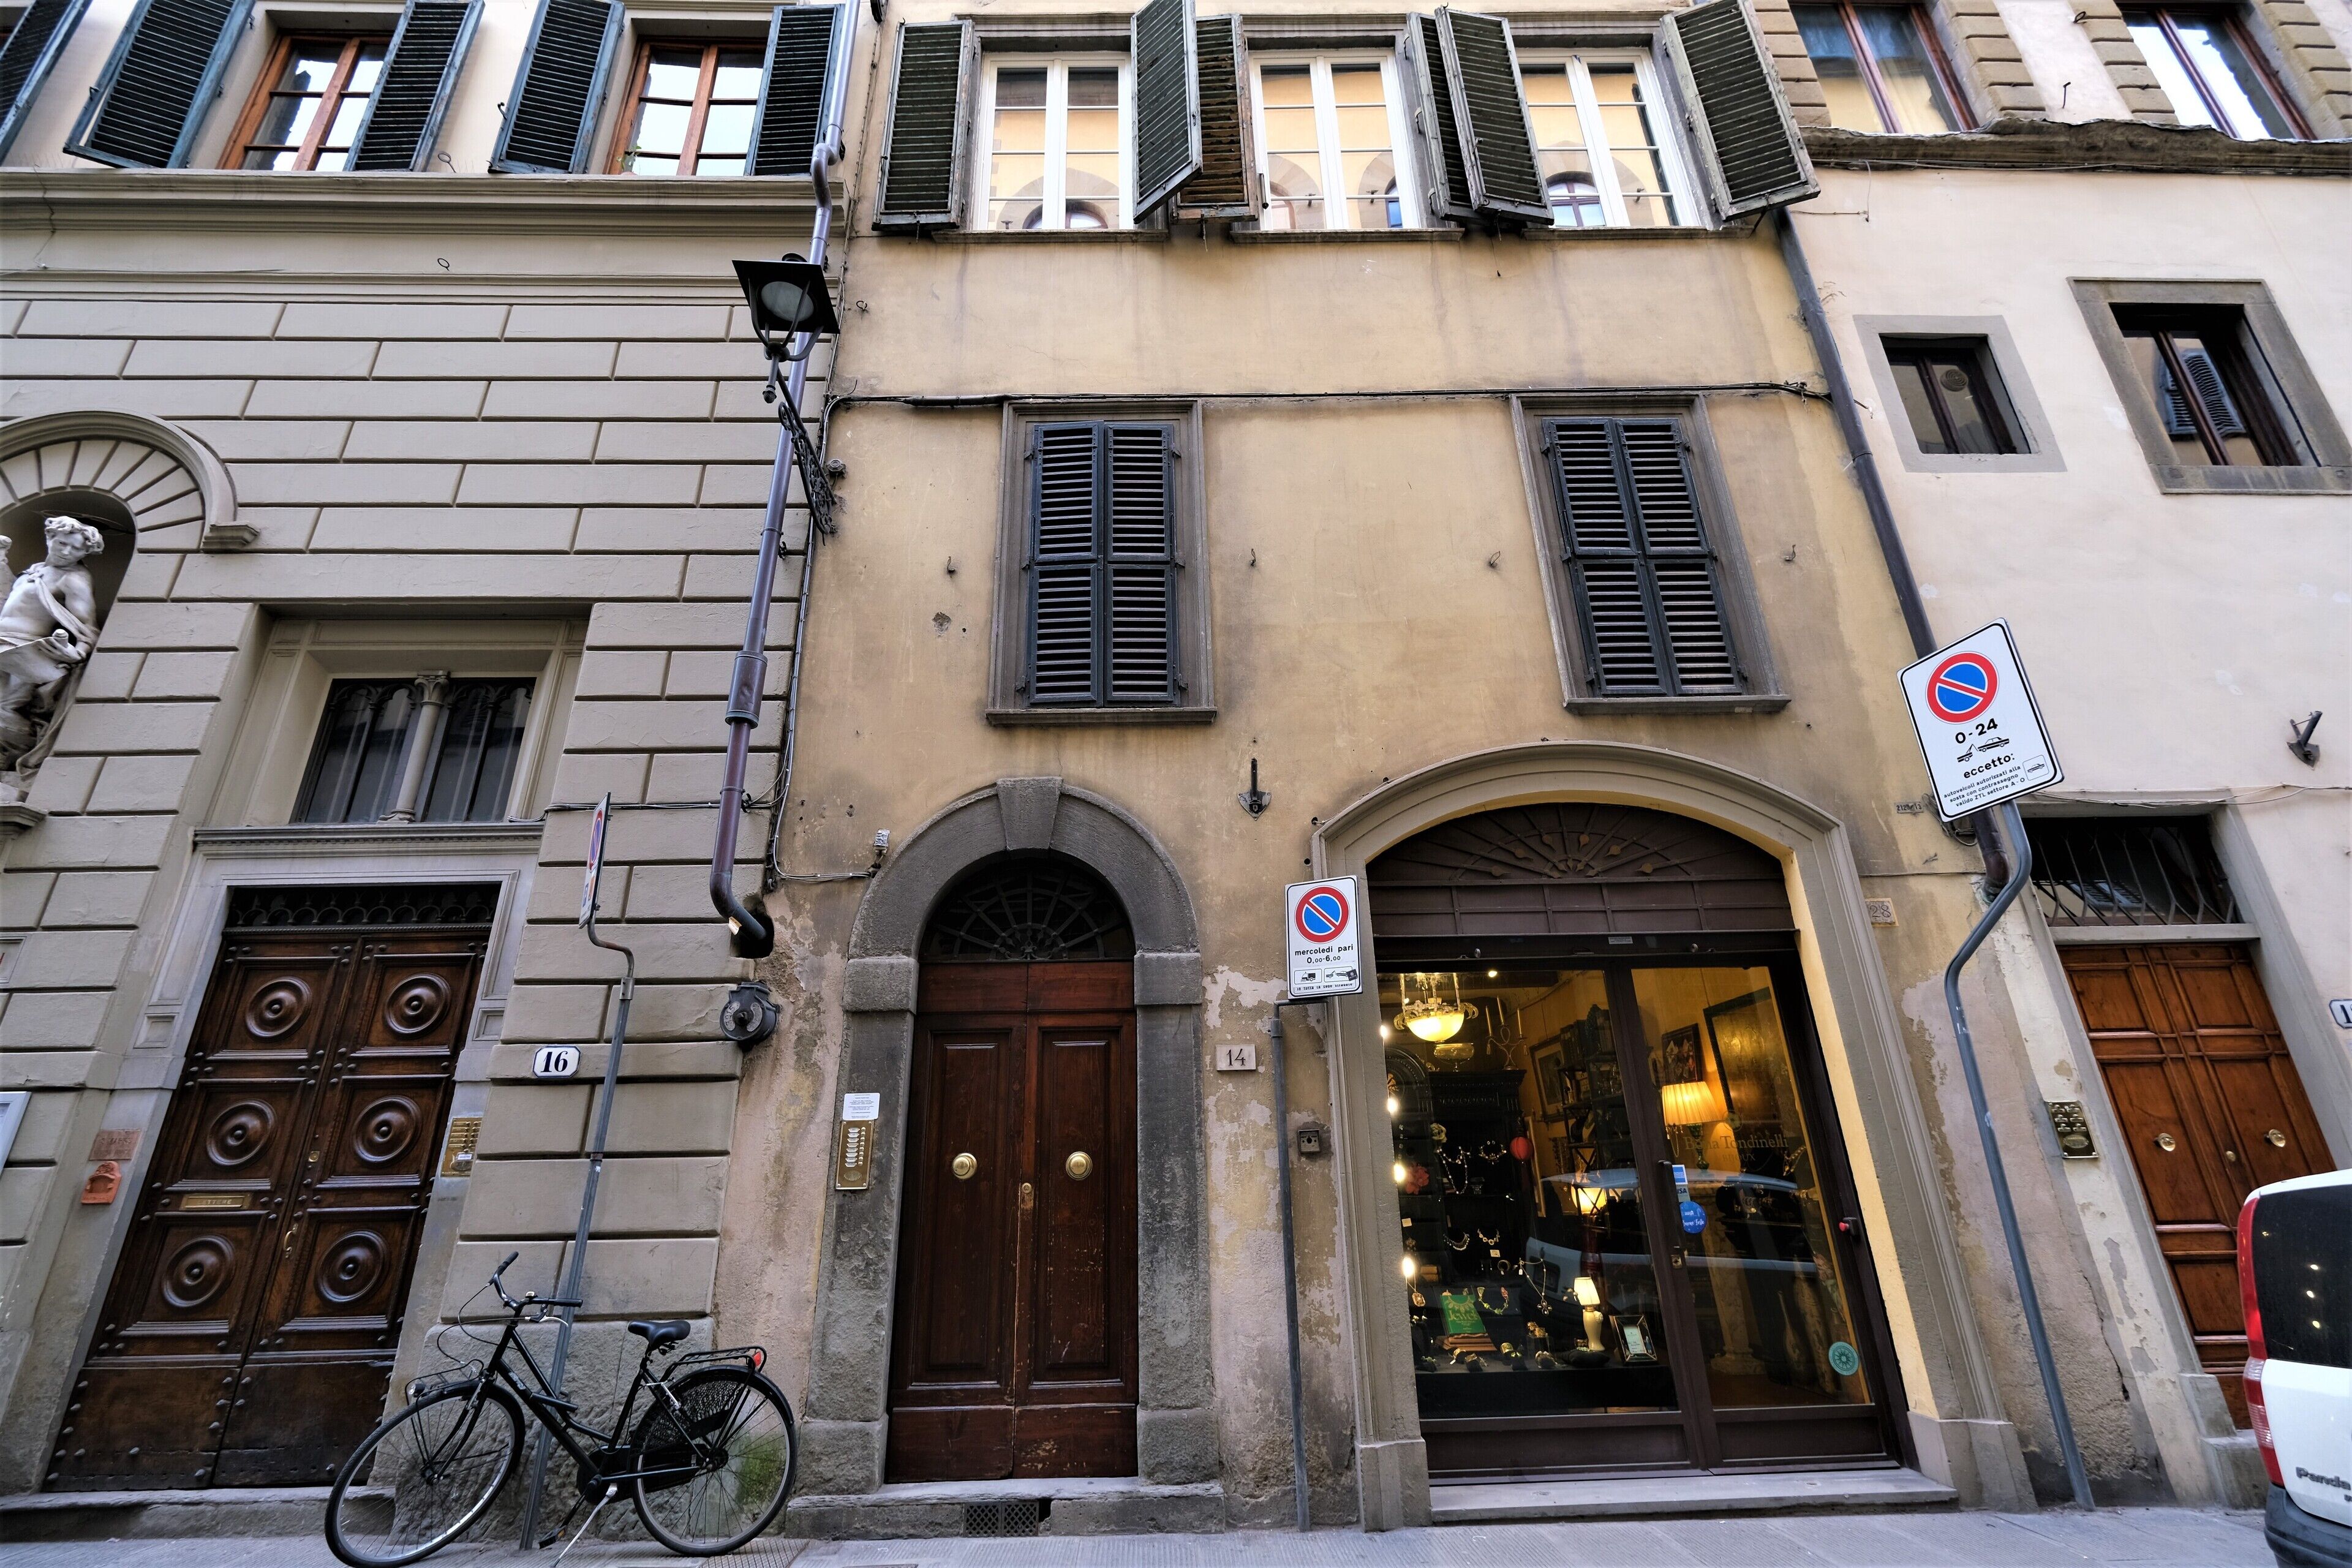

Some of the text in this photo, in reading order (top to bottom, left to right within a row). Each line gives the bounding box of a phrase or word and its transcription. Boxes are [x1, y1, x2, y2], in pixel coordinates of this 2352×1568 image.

[1964, 753, 2015, 778] eccetto:
[1944, 783, 1975, 798] autoveicoli
[1977, 769, 2008, 785] autorizzati
[1950, 794, 1965, 802] sosta
[1978, 774, 2019, 791] contrassegno
[1956, 797, 1973, 807] valido
[1987, 784, 2009, 795] settore
[1869, 905, 1891, 918] 28
[1338, 944, 1354, 953] pari
[2340, 1005, 2352, 1023] 1
[540, 1050, 568, 1072] 16
[1226, 1048, 1246, 1066] 14
[1720, 1134, 1789, 1149] Tondinelli
[2296, 1466, 2351, 1491] Panda
